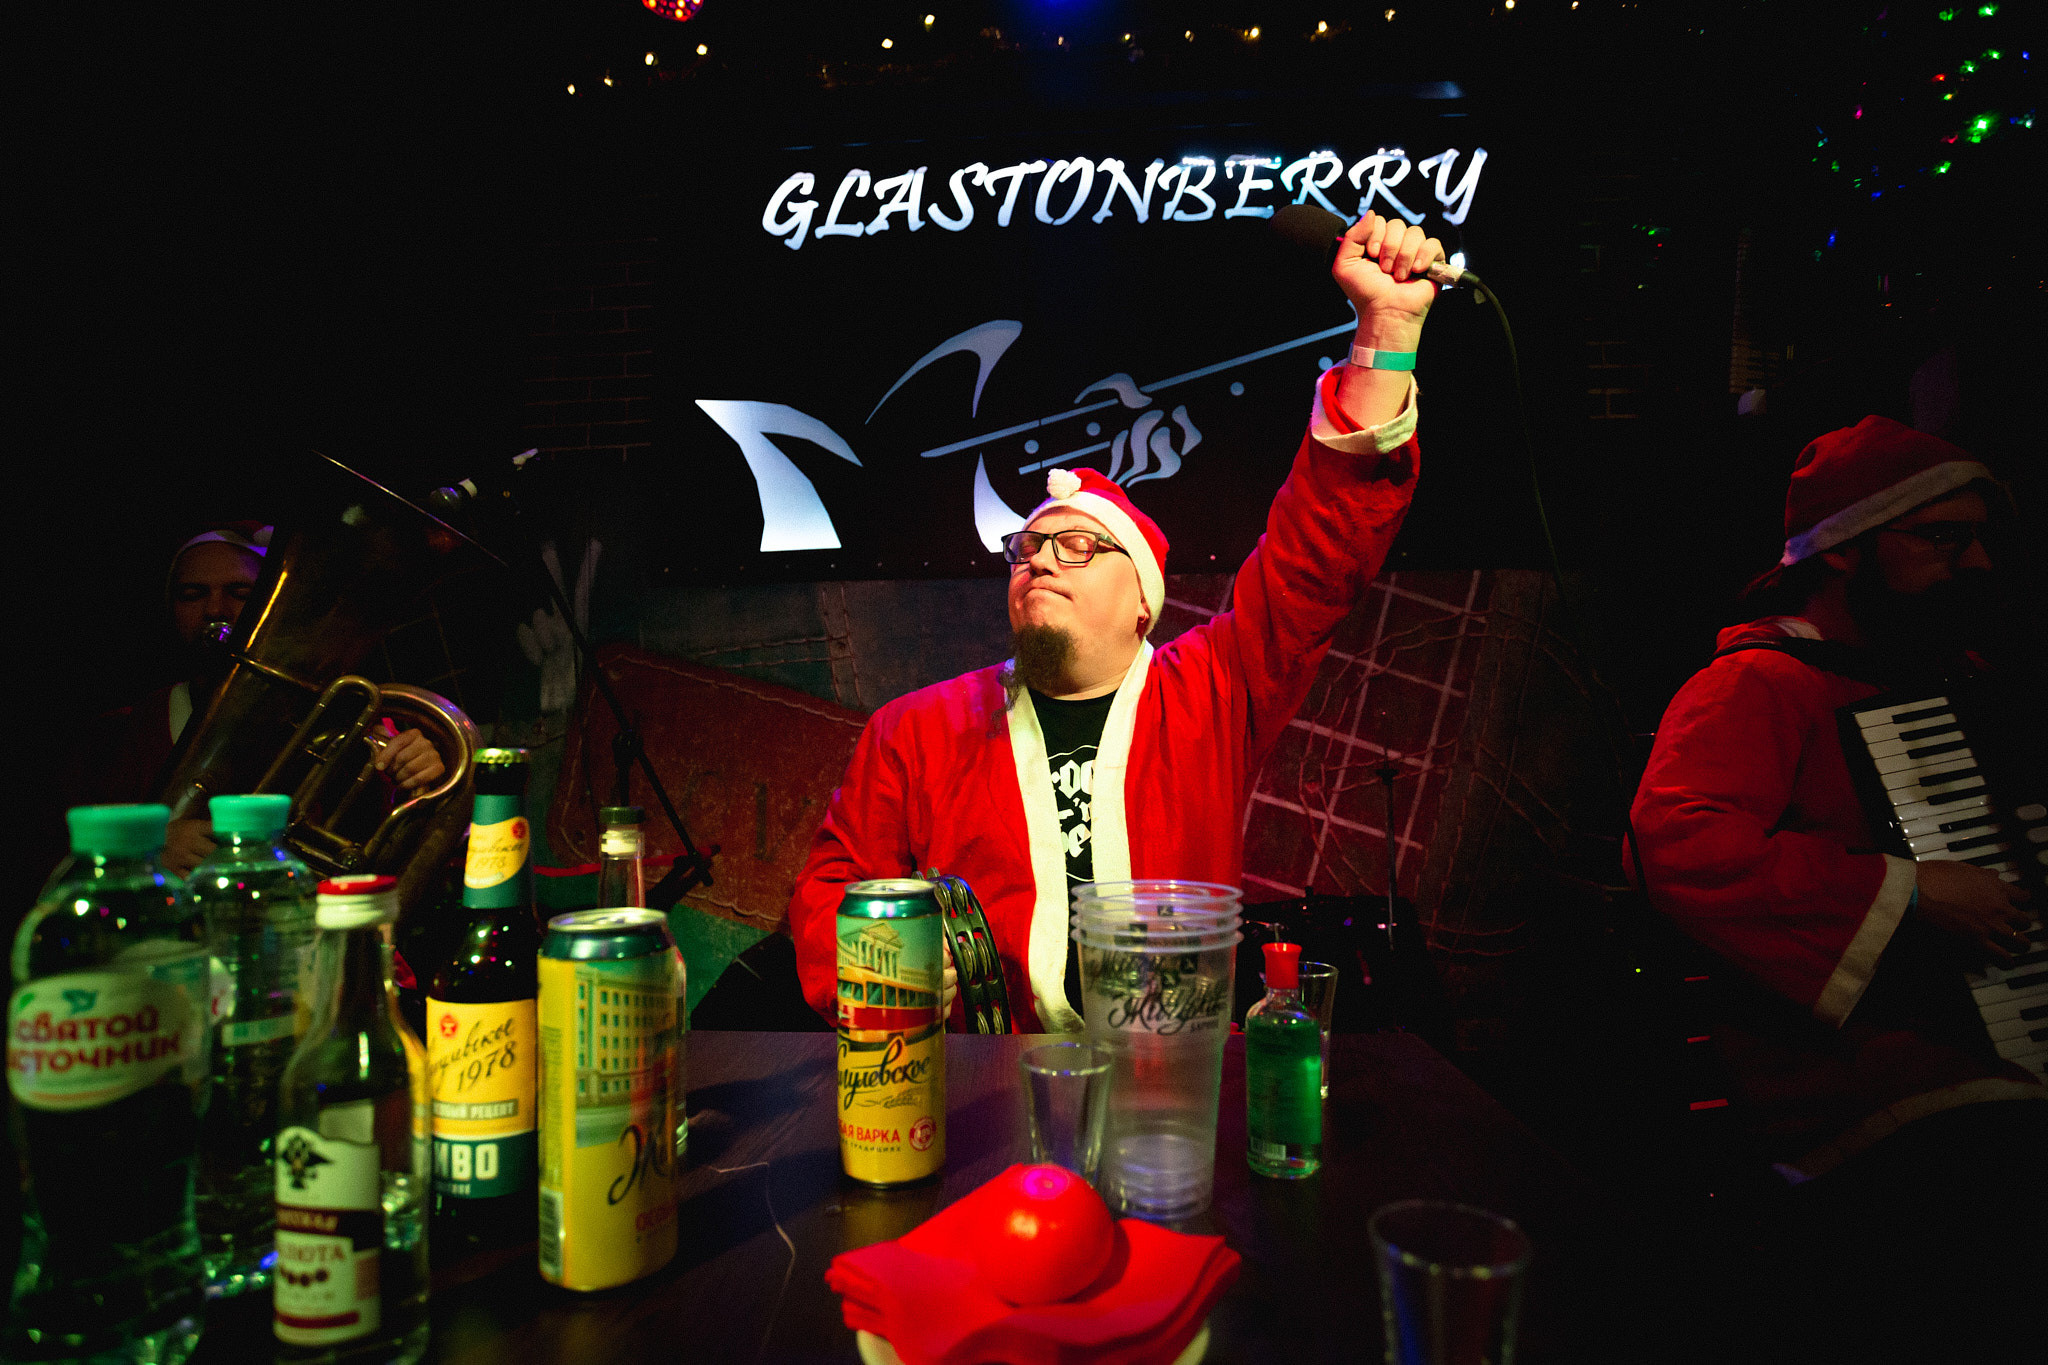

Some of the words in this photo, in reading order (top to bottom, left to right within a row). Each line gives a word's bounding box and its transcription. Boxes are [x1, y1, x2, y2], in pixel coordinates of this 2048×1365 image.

[761, 147, 1489, 251] GLASTONBERRY
[456, 1039, 517, 1092] 1978
[856, 1126, 901, 1144] ВАРКА
[434, 1140, 500, 1181] ИВО
